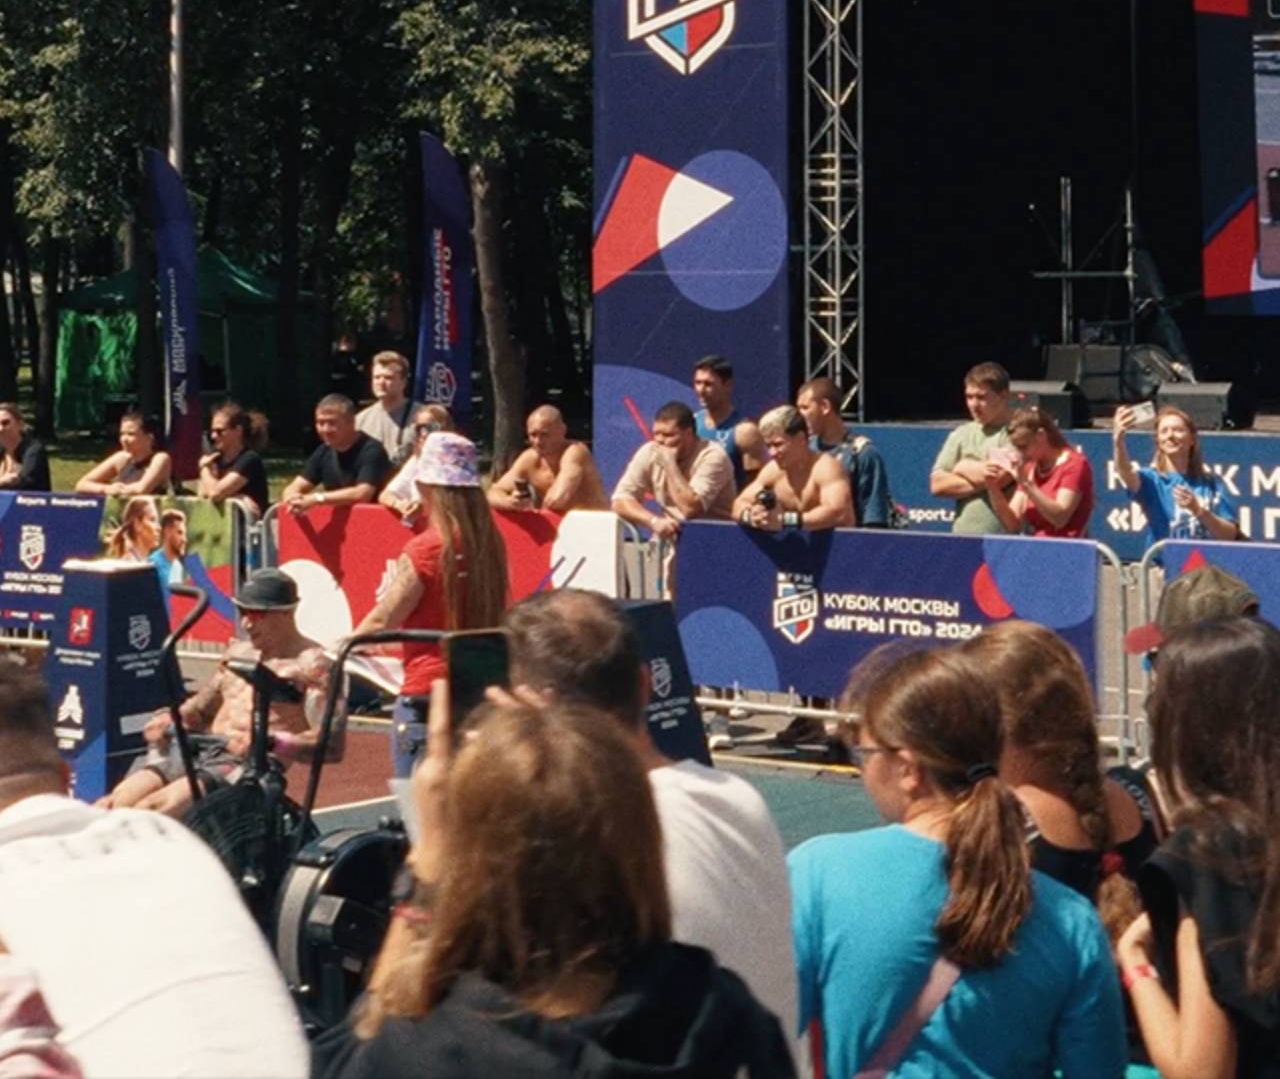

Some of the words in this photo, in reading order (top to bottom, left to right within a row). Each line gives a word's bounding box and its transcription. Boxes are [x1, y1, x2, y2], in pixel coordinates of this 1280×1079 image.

[777, 572, 813, 583] ИГРЫ
[780, 598, 812, 620] ГТО
[824, 593, 880, 610] КУБОК
[884, 596, 959, 617] МОСКВЫ
[825, 615, 884, 633] «ИГРЫ
[889, 618, 932, 636] ГТО»
